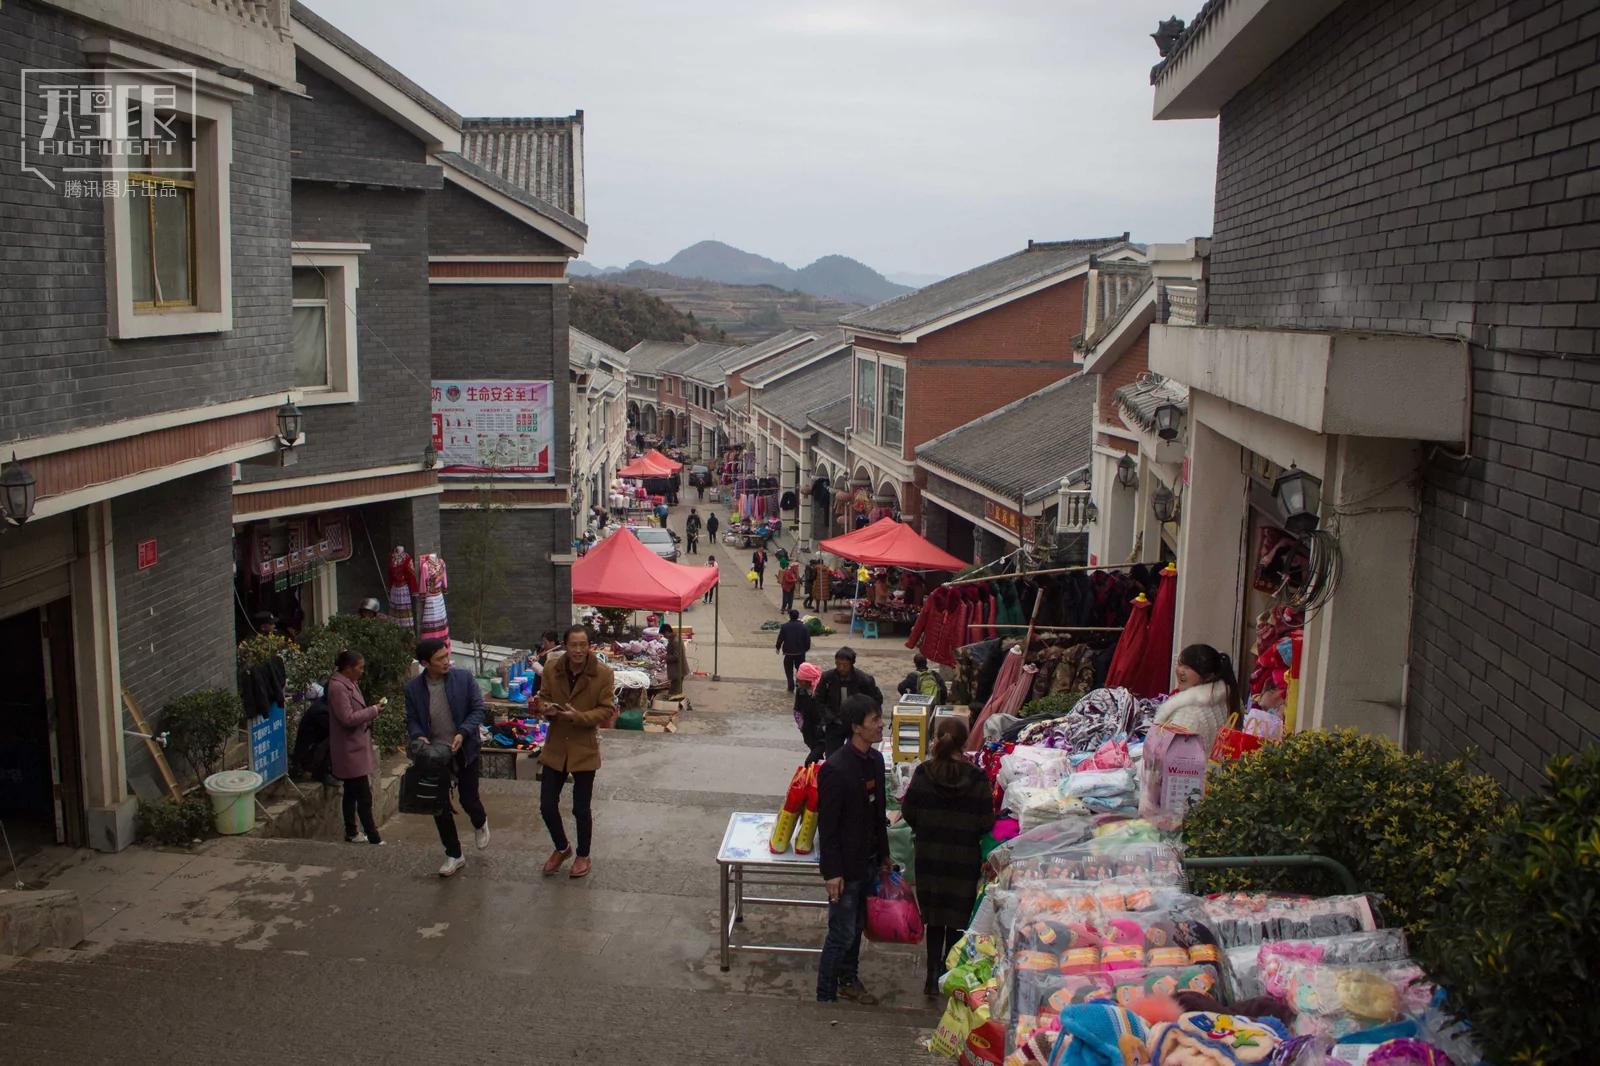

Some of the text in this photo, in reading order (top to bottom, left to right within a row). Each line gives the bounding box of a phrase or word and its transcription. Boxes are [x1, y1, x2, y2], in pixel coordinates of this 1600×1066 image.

[466, 386, 539, 402] 生命安全至上
[1168, 766, 1199, 776] Warmth
